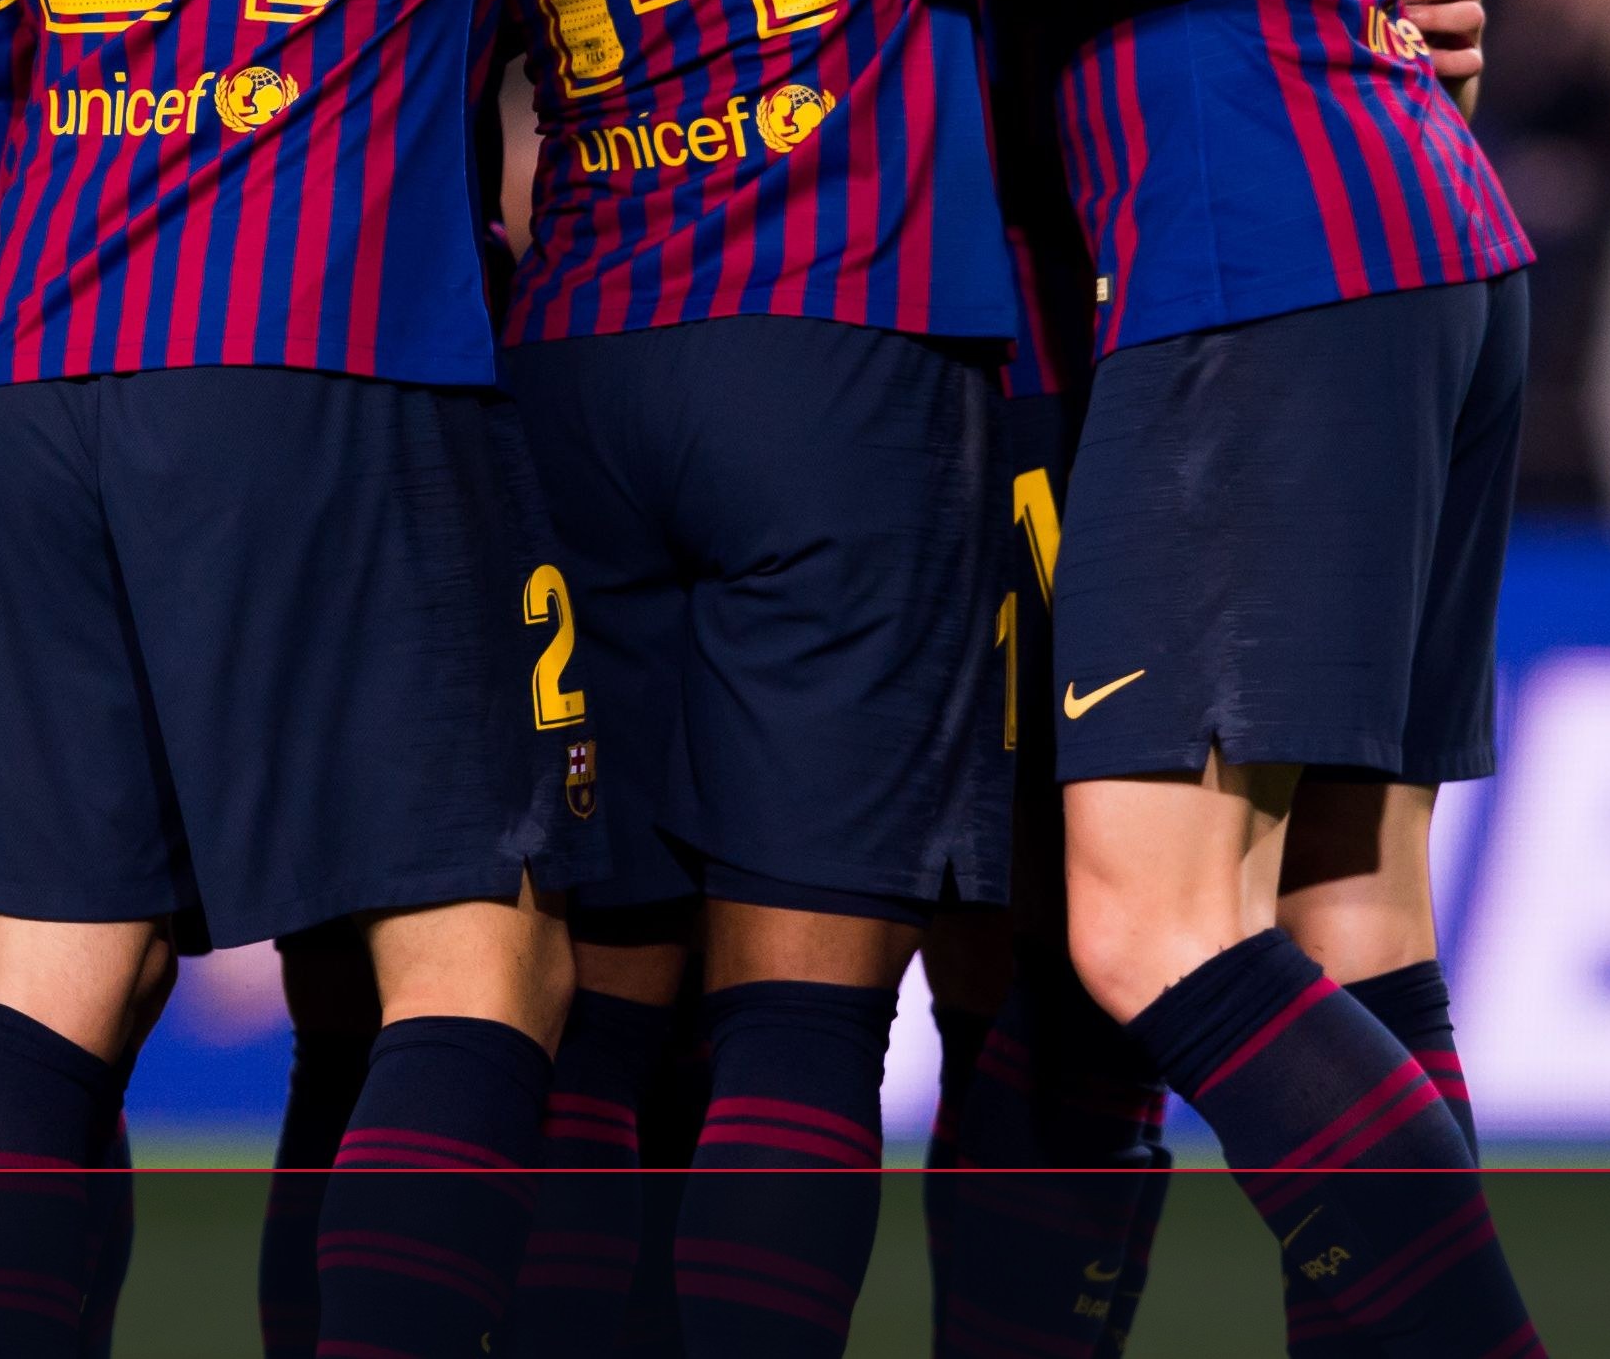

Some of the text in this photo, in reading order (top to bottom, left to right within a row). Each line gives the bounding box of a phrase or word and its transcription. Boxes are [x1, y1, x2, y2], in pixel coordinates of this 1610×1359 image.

[48, 71, 217, 137] unicef
[578, 95, 750, 175] unicef
[523, 563, 586, 732] 2
